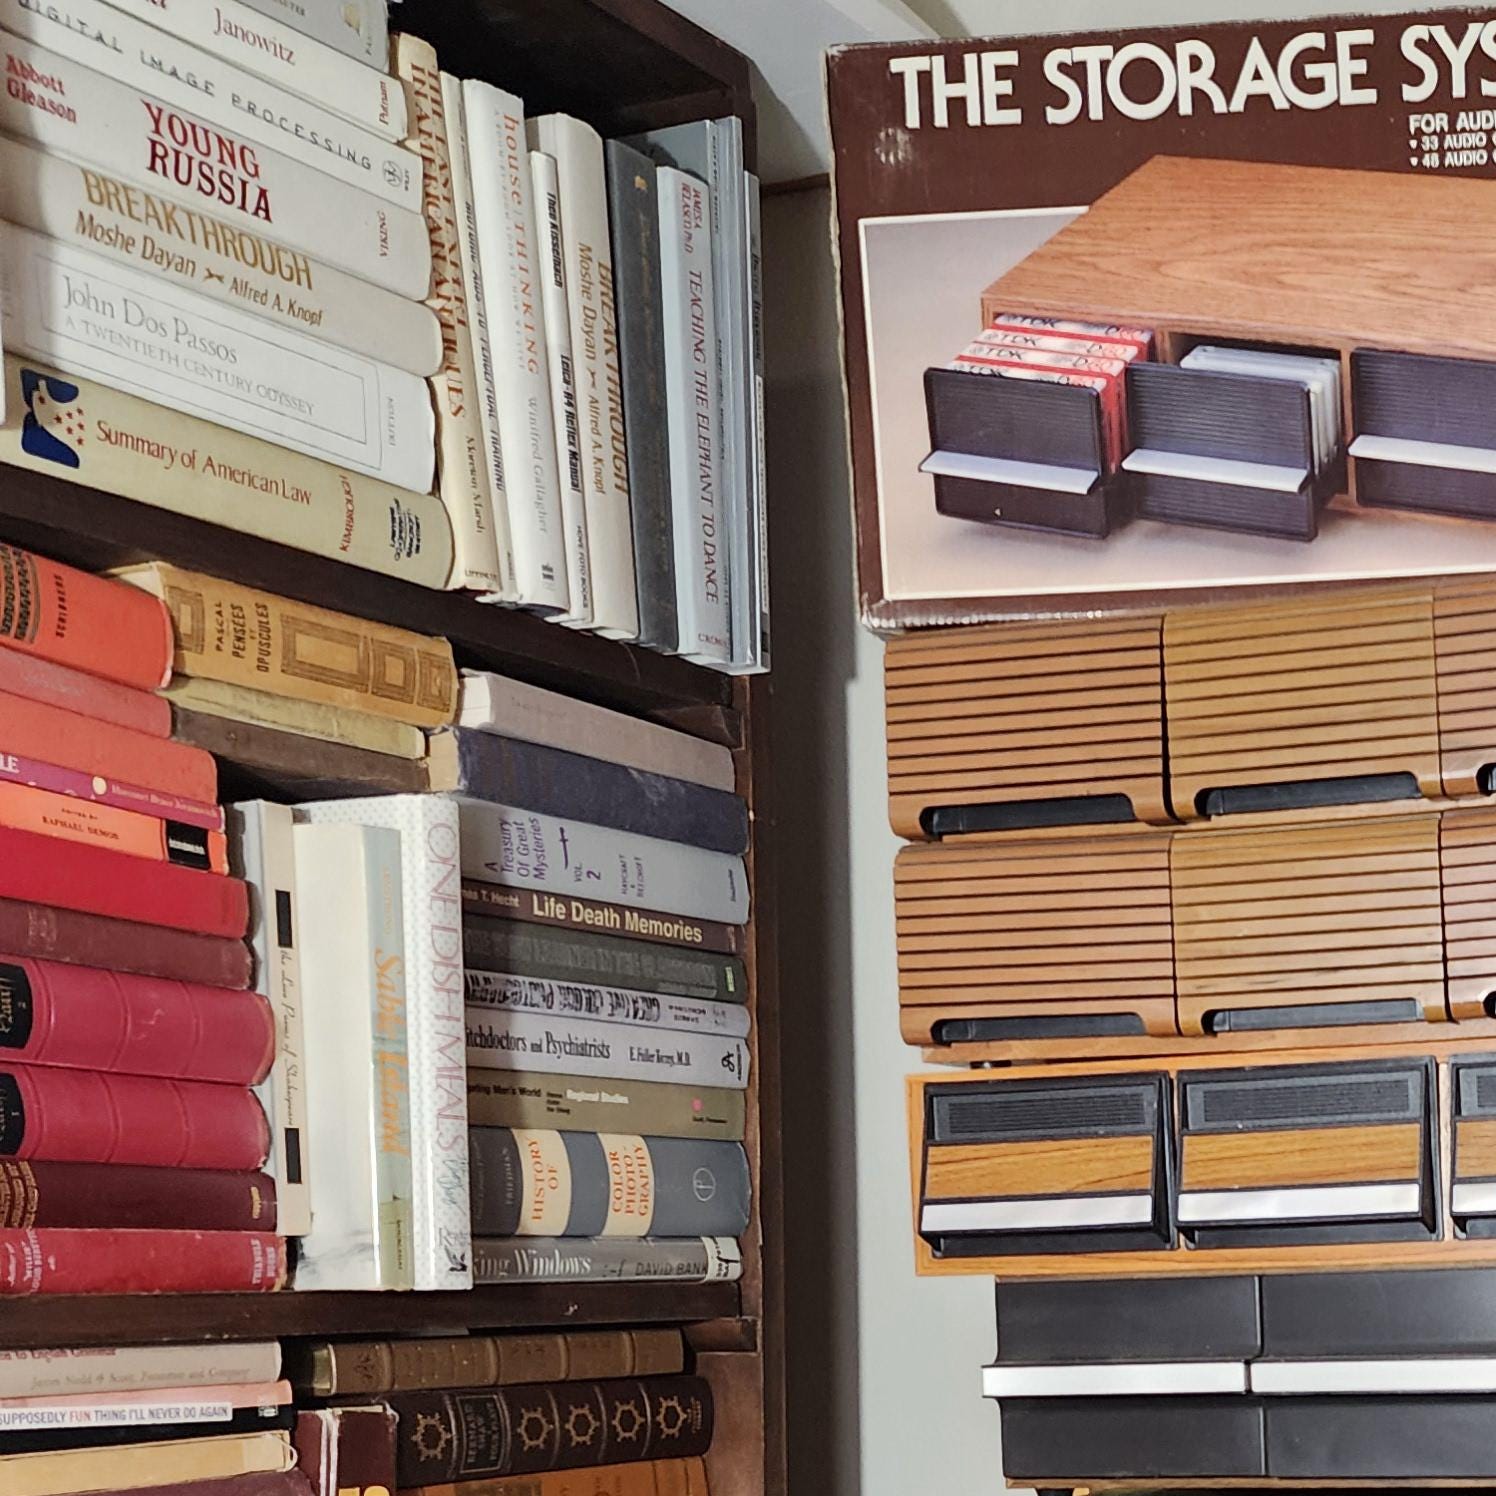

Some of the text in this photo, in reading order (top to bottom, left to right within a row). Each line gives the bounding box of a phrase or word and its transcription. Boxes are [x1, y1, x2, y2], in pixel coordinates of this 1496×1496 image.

[213, 8, 296, 66] Janowitz
[5, 54, 66, 96] Abbott
[6, 80, 78, 124] Gleason
[379, 80, 389, 126] Putnam
[889, 50, 1022, 129] THE
[1043, 29, 1379, 126] STORAGE
[139, 49, 215, 97] IMAGE
[231, 93, 373, 171] PROCESSING
[142, 99, 260, 179] YOUNG
[1409, 114, 1448, 134] FOR
[1444, 131, 1486, 149] AUDIO
[146, 138, 273, 223] RUSSIA
[1444, 149, 1487, 167] AUDIO
[76, 211, 197, 278] Moshe Dayan
[81, 168, 313, 291] BREAKTHROUGH
[379, 210, 390, 258] VIKING
[62, 276, 238, 364] John Dos Passos
[229, 277, 324, 327] Alfred A. Knopf
[515, 222, 539, 375] THINKING
[578, 243, 598, 361] Moshe Dayan
[66, 318, 315, 416] A TWENTIETH CENTURY ODYSSEY
[598, 260, 629, 495] BREAKTHROUGH
[96, 421, 313, 506] Summary of American Law
[588, 394, 607, 496] Alfred Knopf
[689, 271, 719, 603] TEACHING THE ELEPHANT TO DANCE
[569, 451, 582, 494] Manual
[215, 600, 224, 652] PASCAL
[257, 602, 270, 673] OPUSCULES
[484, 862, 499, 872] A
[500, 819, 514, 874] Treasury
[515, 820, 530, 878] Of Great
[530, 817, 549, 880] Mysteries
[586, 869, 602, 880] 2
[532, 893, 703, 942] Life Death Memories
[426, 820, 466, 1153] ONE DISH MEALS
[373, 947, 410, 1156] Sable Island
[545, 1030, 611, 1060] Psychiatrists
[283, 1062, 296, 1127] Shakespeare
[527, 1137, 544, 1221] HISTORY
[548, 1165, 558, 1190] OF
[609, 1151, 622, 1213] COLOR
[635, 1145, 649, 1217] GRAPHY
[514, 1249, 592, 1277] Windows
[69, 1409, 91, 1422] FUN
[94, 1408, 126, 1421] THING
[128, 1408, 146, 1420] I'LL
[149, 1407, 182, 1419] NEVER
[183, 1407, 196, 1418] DO
[199, 1406, 228, 1418] AGAIN
